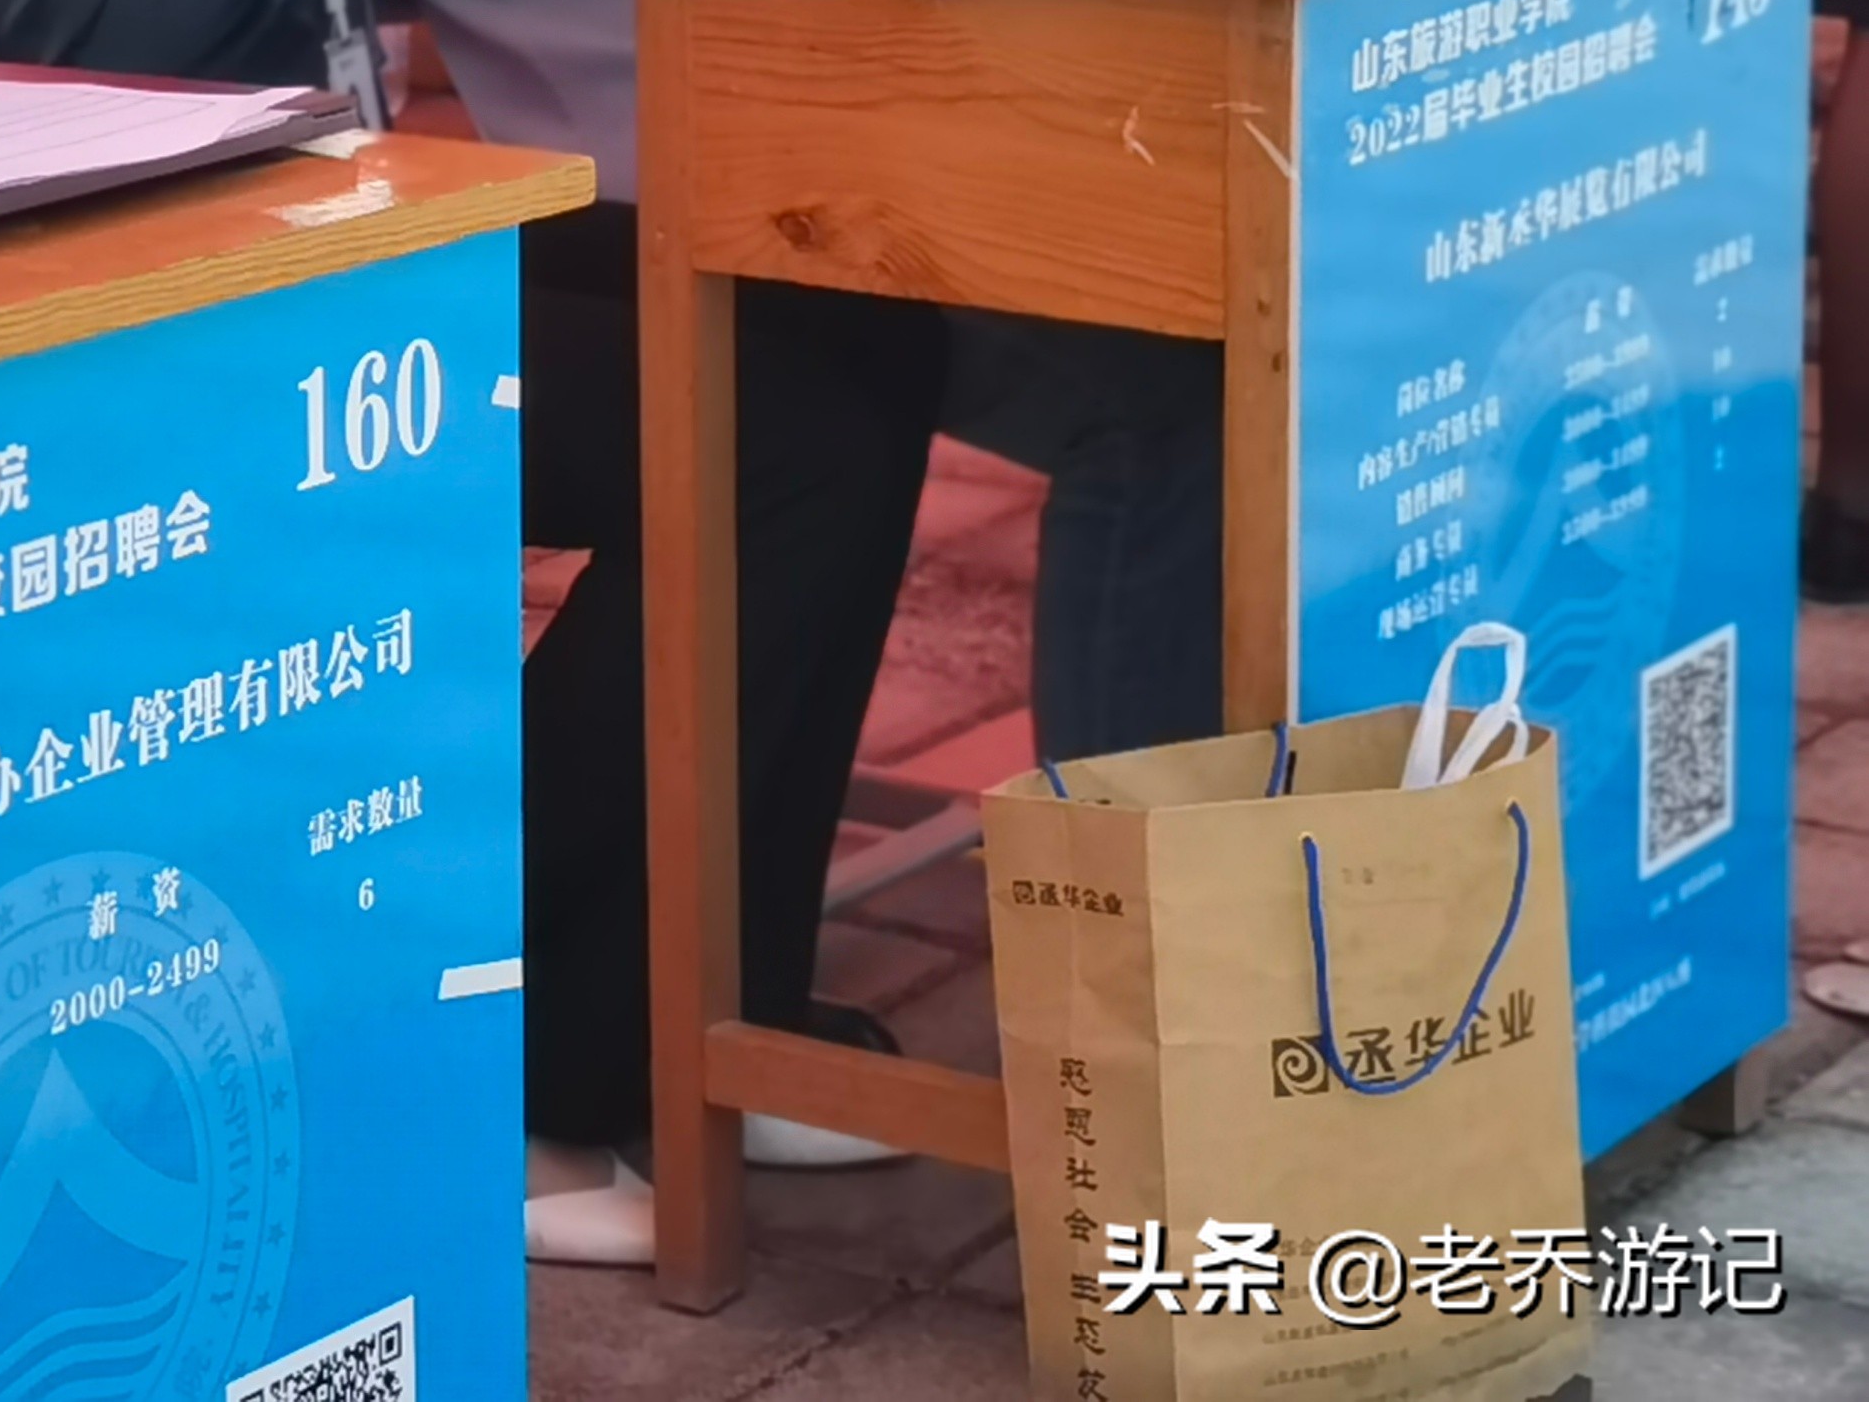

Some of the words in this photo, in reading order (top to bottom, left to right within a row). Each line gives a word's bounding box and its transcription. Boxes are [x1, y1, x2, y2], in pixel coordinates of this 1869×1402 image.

[1349, 11, 1658, 166] 2022届毕业生校园招聘会
[296, 337, 442, 492] 160
[308, 774, 424, 857] 需求数量
[358, 876, 376, 912] 6
[49, 937, 221, 1036] 2000-2499
